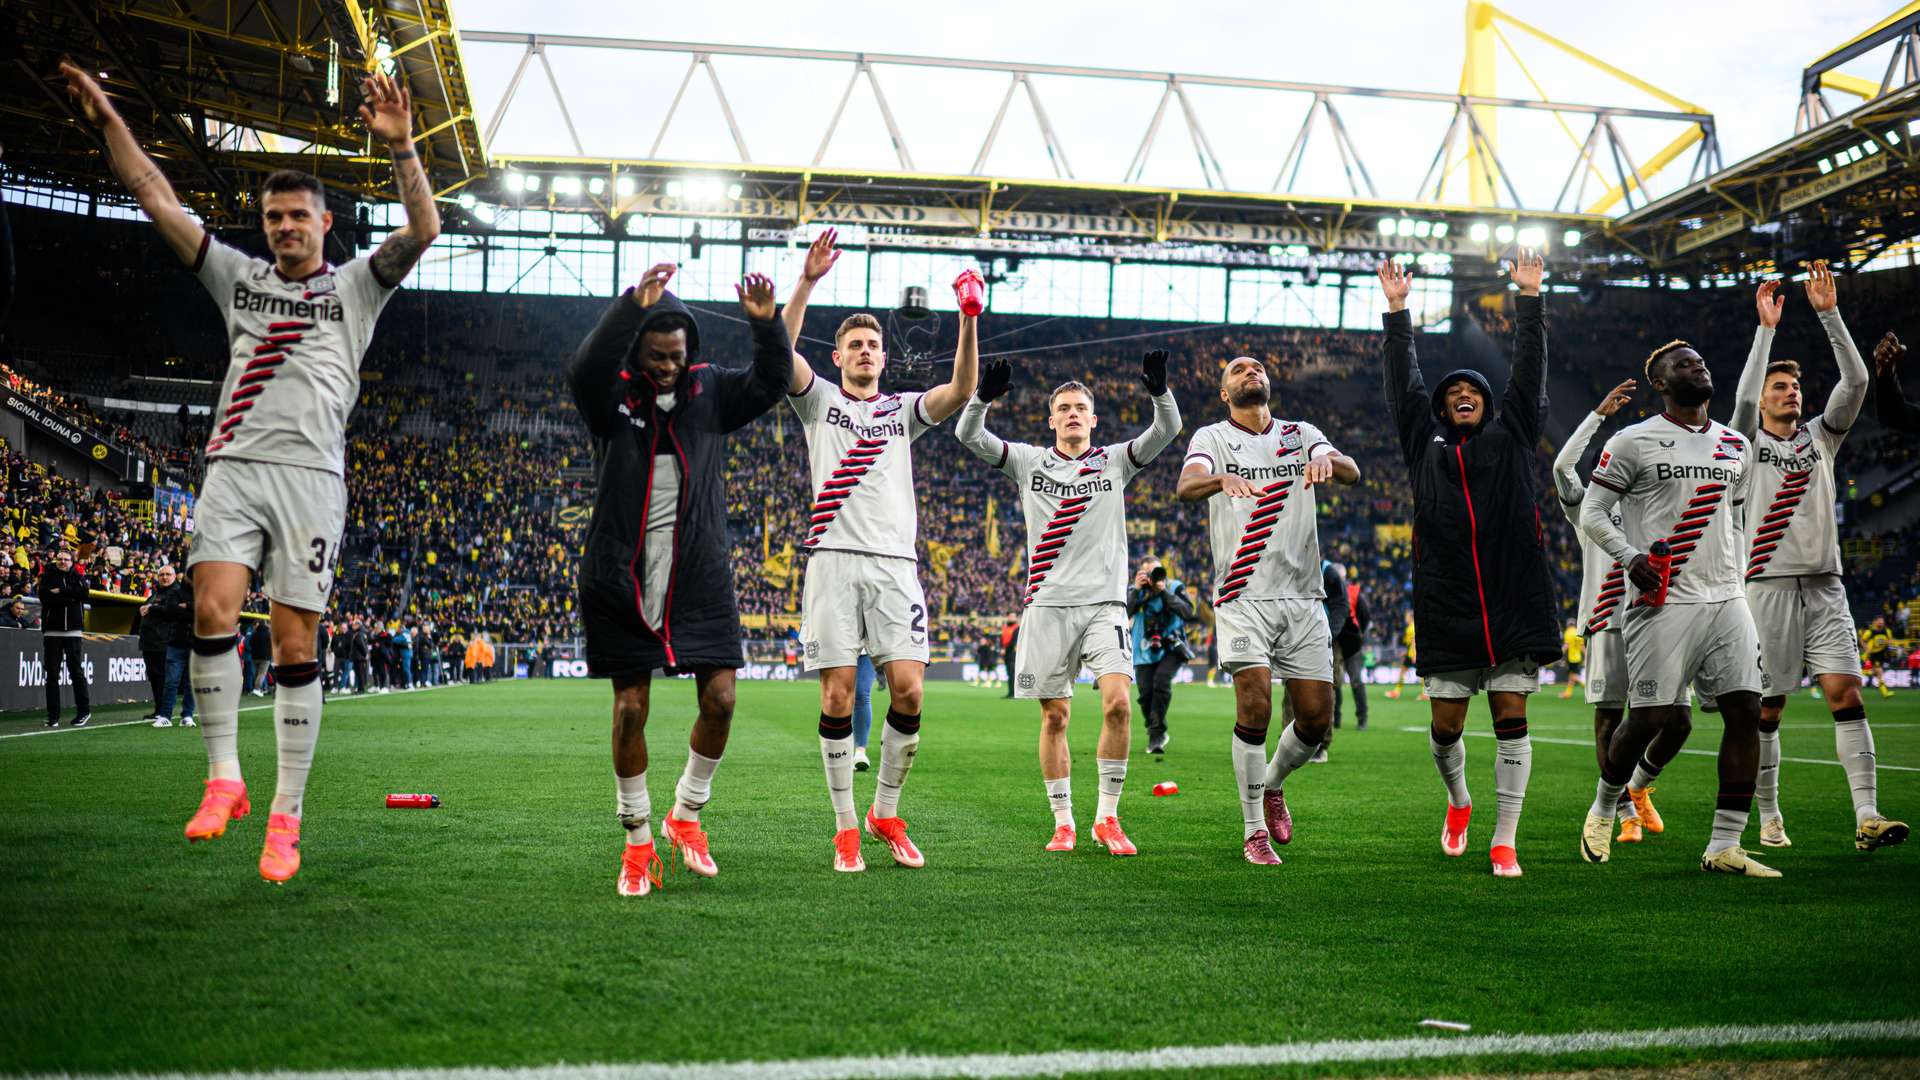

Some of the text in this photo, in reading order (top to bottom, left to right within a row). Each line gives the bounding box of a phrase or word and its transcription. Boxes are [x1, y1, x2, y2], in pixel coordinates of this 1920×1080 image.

[809, 202, 926, 223] WAND
[233, 286, 345, 322] Barmenia
[7, 397, 71, 439] SIGNAL IDUNA
[1758, 447, 1822, 471] Barmeni
[1031, 475, 1112, 497] Barmenia
[910, 603, 925, 633] 2
[108, 657, 147, 682] ROSIER
